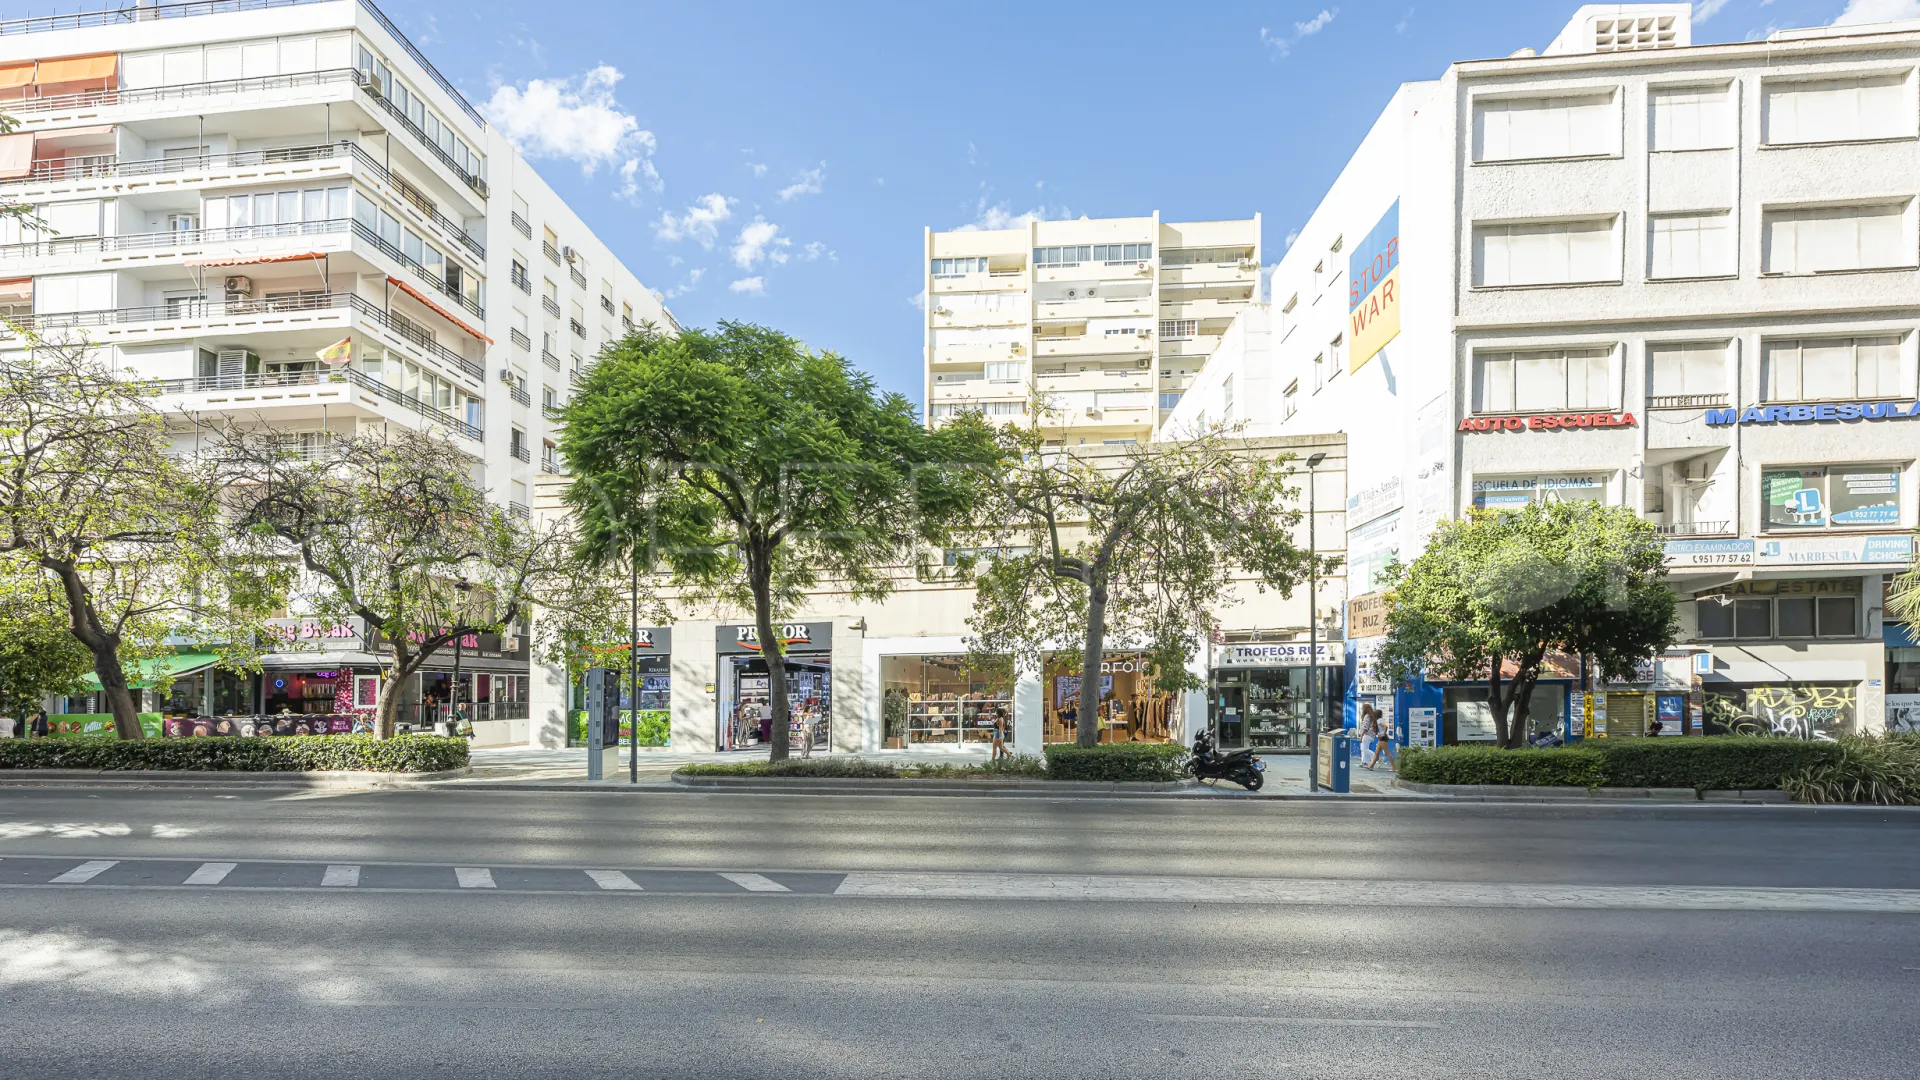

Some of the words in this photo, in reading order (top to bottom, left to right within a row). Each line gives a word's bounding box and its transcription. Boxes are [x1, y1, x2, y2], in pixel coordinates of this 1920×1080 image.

[1350, 236, 1398, 307] STOP
[1353, 278, 1394, 336] WAR
[1458, 416, 1522, 431] AUTO
[1528, 412, 1637, 429] ESCUELA
[1473, 479, 1518, 491] ESCUELA
[1523, 479, 1537, 488] DE
[1544, 477, 1593, 488] IDIOMAS
[1664, 543, 1693, 553] ENTRO
[1694, 542, 1750, 552] EXAMINADOR
[1868, 539, 1908, 549] DRIVING
[1699, 555, 1714, 563] 951
[1716, 555, 1725, 563] 77
[1728, 554, 1738, 562] 57
[1740, 554, 1750, 562] 62
[1788, 551, 1858, 562] MARBESULA
[1777, 580, 1856, 594] ESTATE
[1353, 596, 1386, 613] TROFEO
[1362, 614, 1379, 628] RUZ
[736, 624, 808, 640] PROR
[1236, 646, 1295, 657] TROFEOS
[1079, 661, 1149, 673] RFOIS
